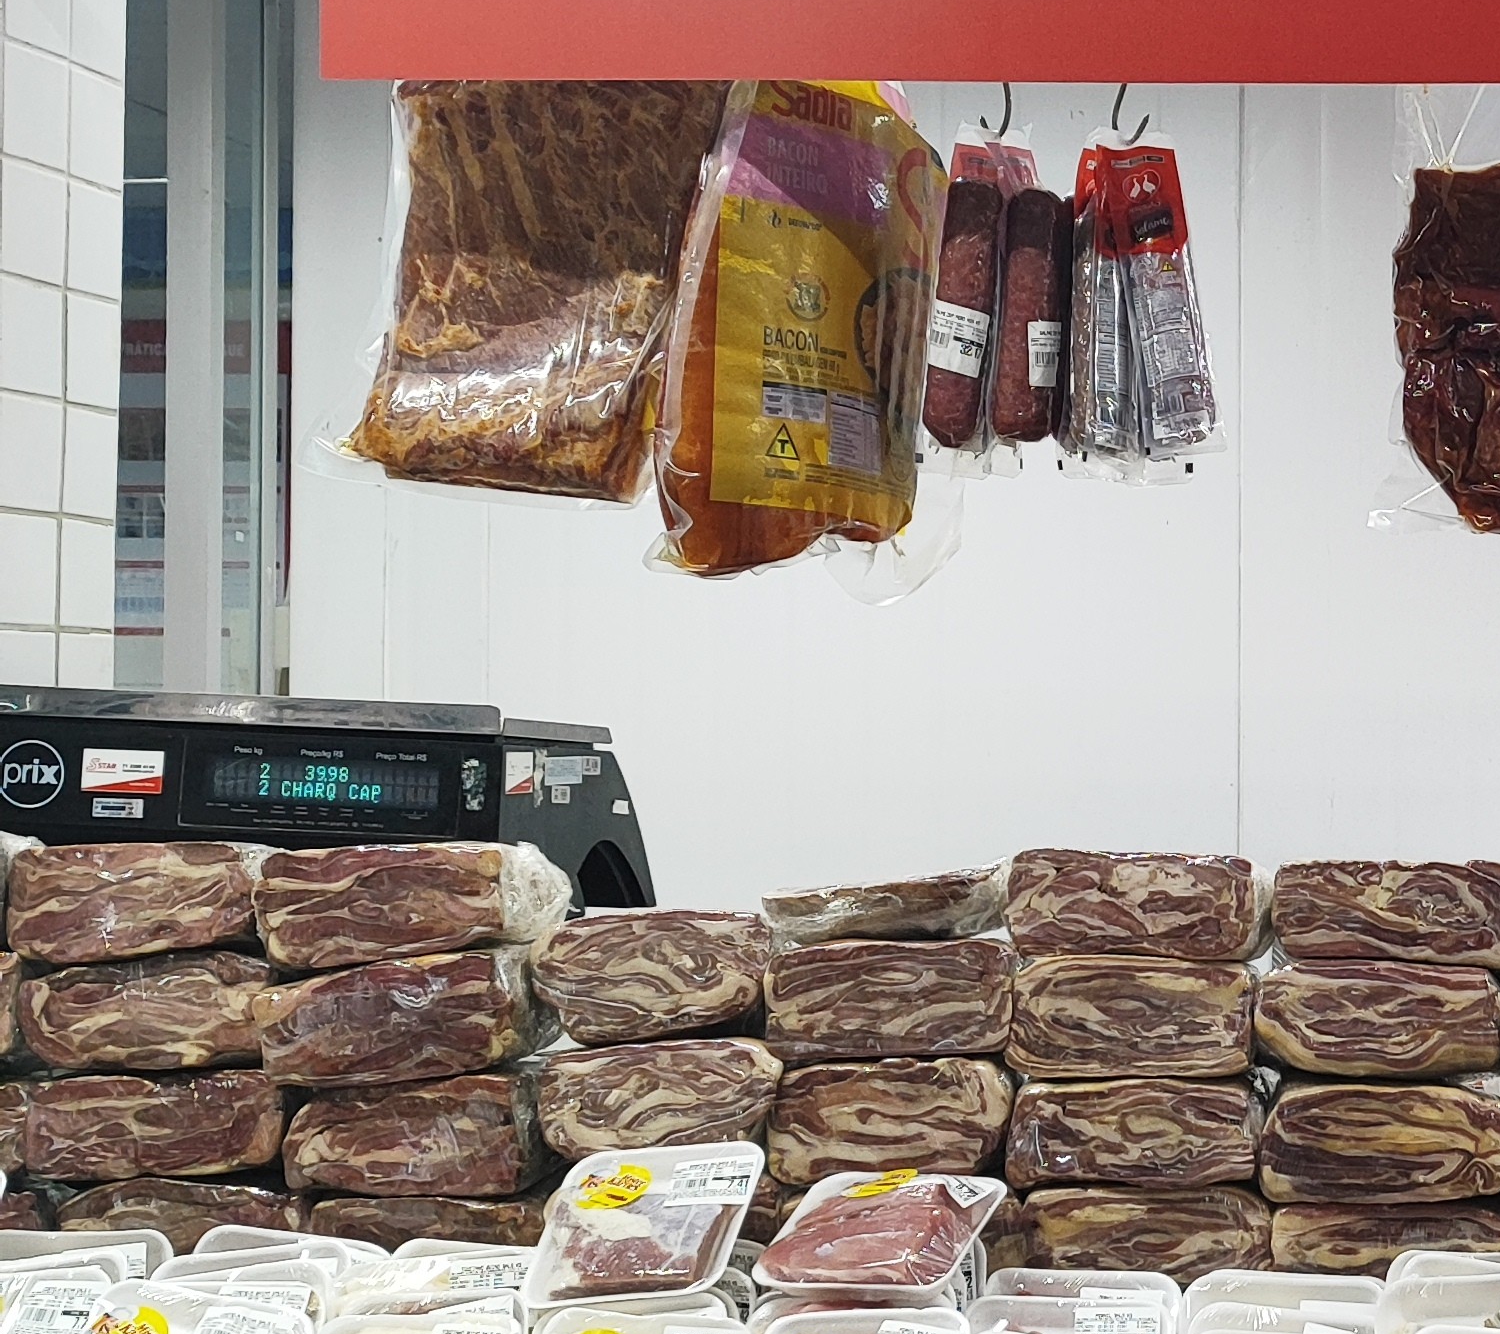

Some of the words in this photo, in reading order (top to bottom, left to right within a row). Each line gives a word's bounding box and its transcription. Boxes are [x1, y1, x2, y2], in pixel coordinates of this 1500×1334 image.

[768, 137, 819, 166] BACON
[763, 325, 819, 352] BACON
[3, 758, 59, 789] prix
[260, 763, 270, 779] 2
[259, 781, 269, 796] 2
[281, 781, 336, 800] CHARQ
[348, 784, 381, 803] CAP
